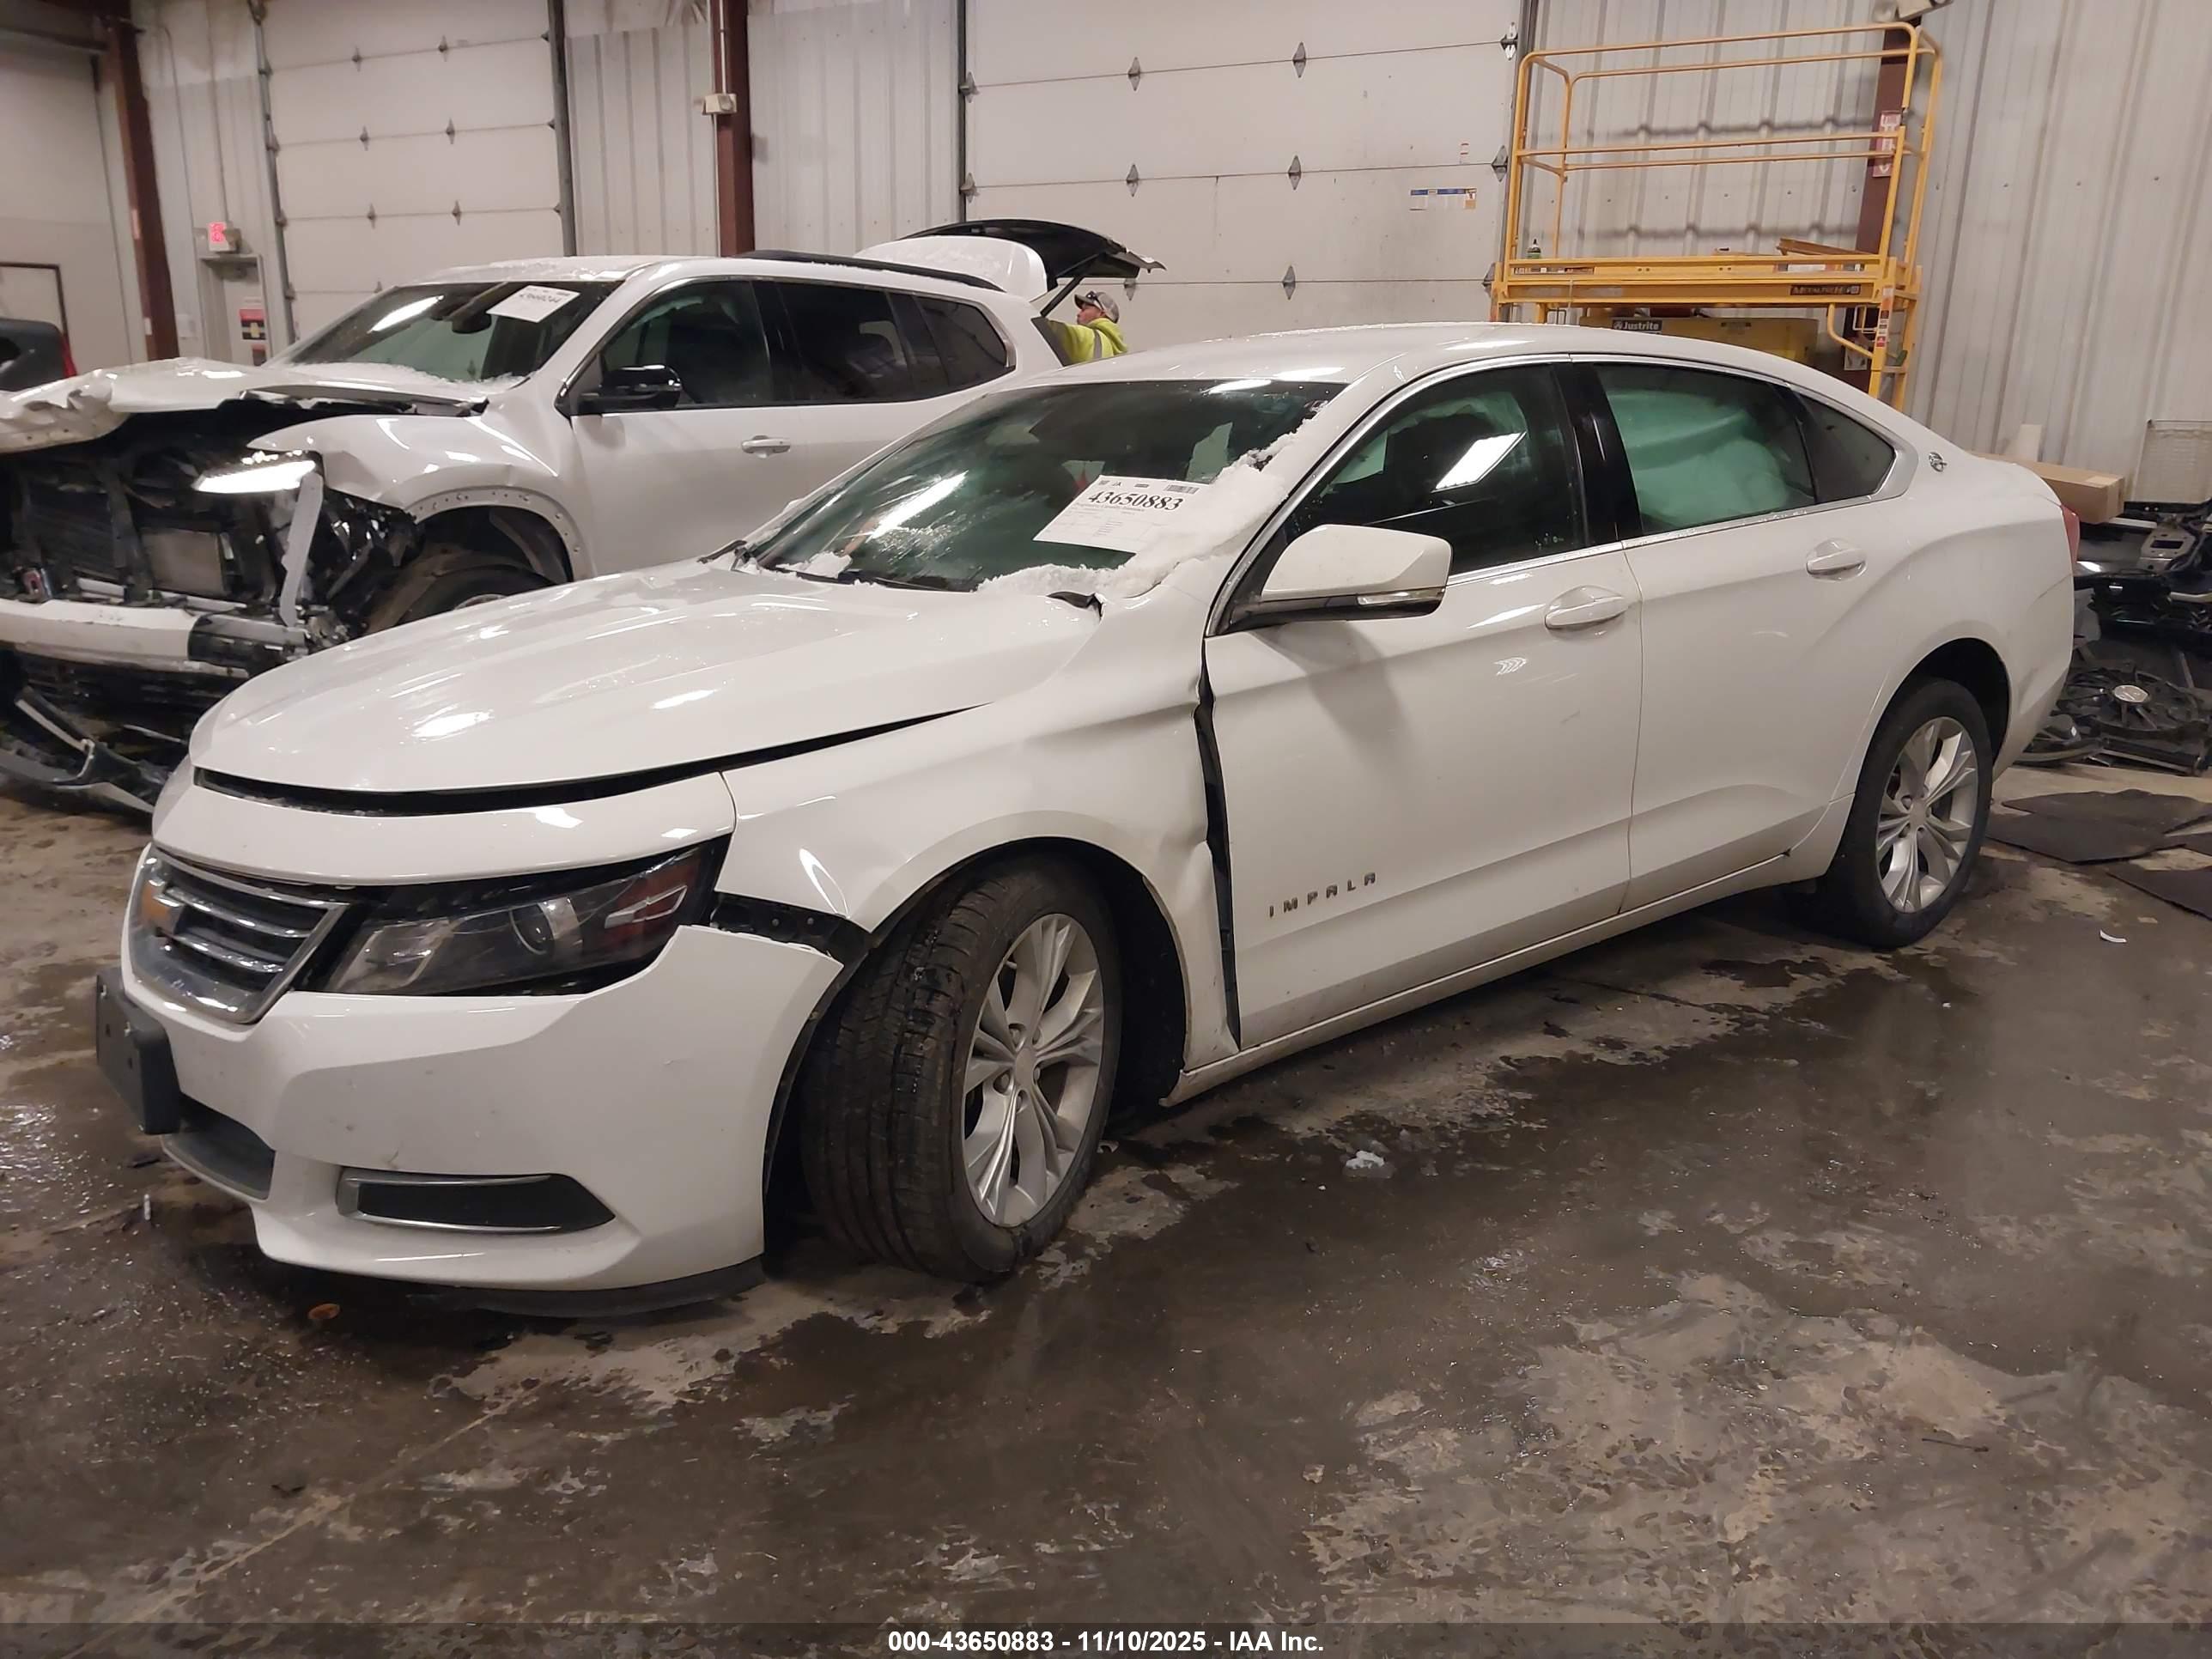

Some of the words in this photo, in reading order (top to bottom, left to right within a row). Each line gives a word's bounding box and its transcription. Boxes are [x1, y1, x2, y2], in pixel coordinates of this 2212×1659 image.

[1623, 321, 1659, 331] Justrite
[1088, 490, 1184, 511] 43650883
[1268, 872, 1376, 918] IMPALA
